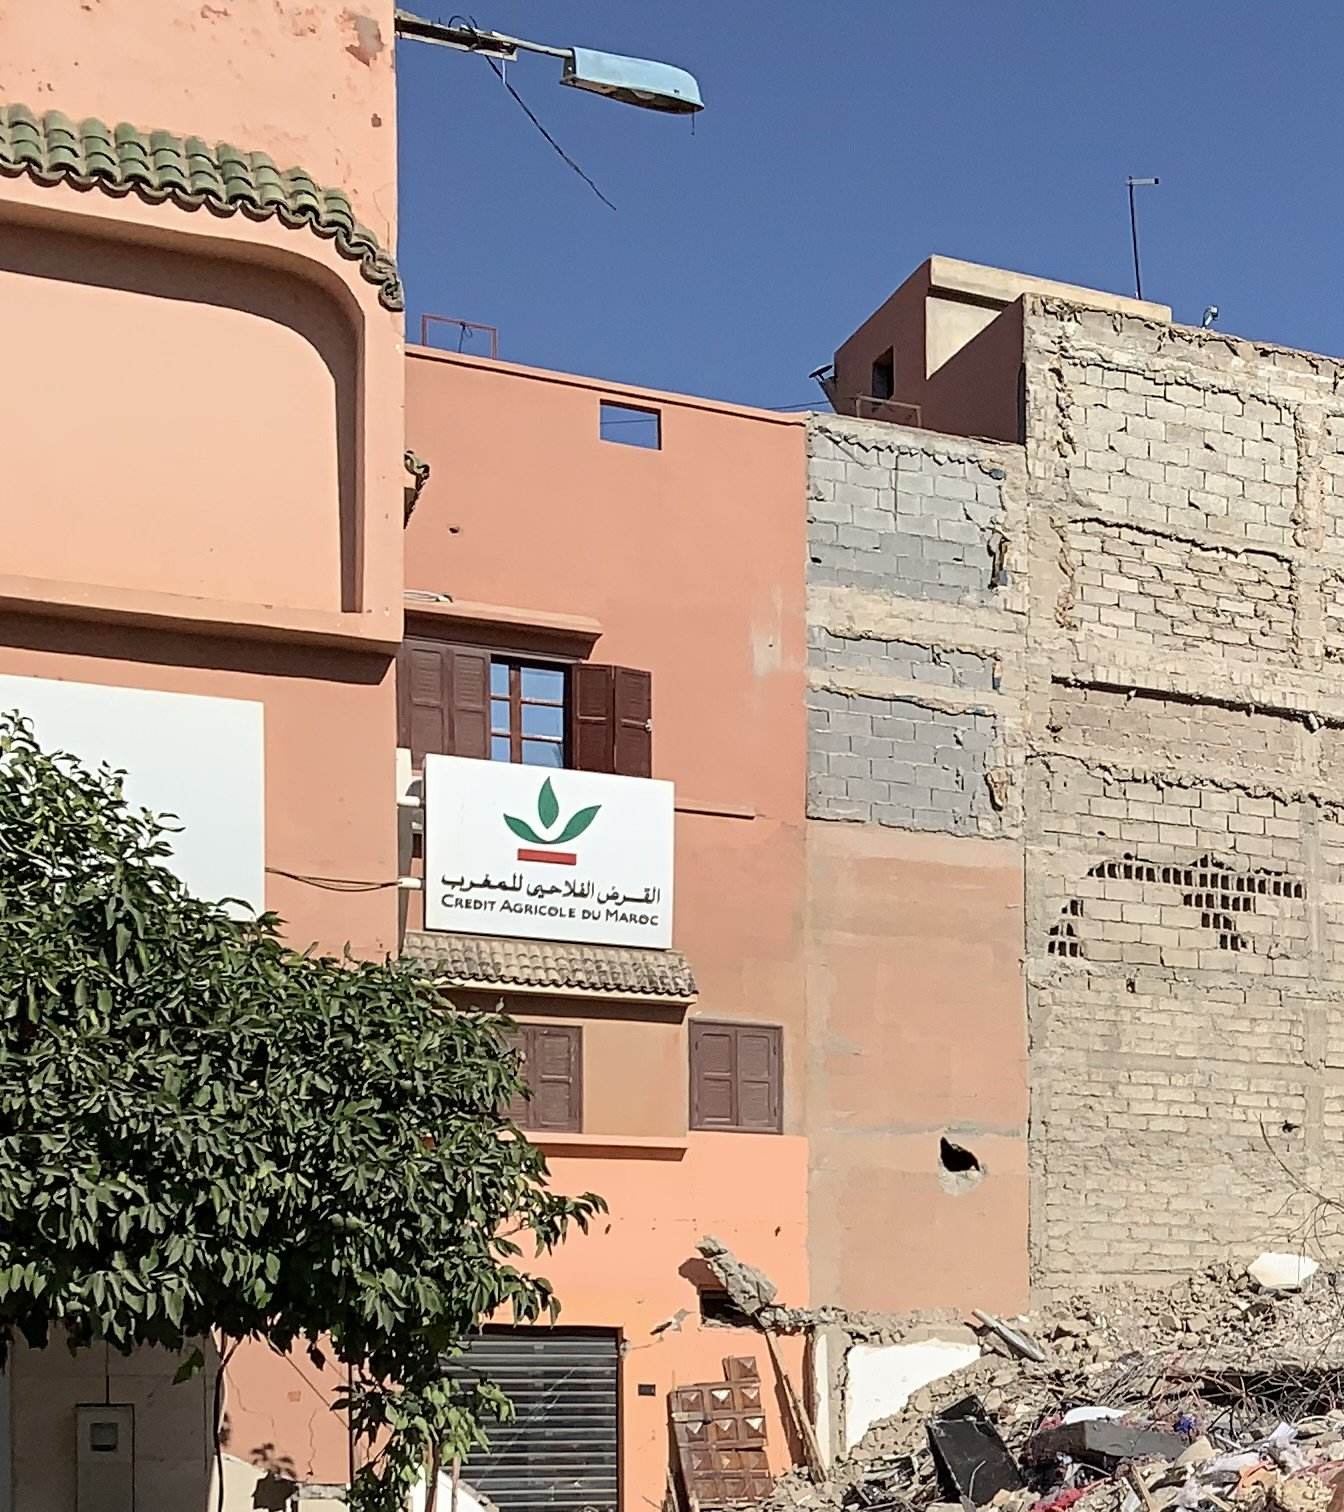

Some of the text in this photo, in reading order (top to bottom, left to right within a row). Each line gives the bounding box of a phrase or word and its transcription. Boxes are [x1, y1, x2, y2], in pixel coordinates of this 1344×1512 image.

[441, 872, 661, 907] القرض الفلاحي للمغرب
[441, 893, 659, 926] CREDIT AGRICOLE DU MAROC
